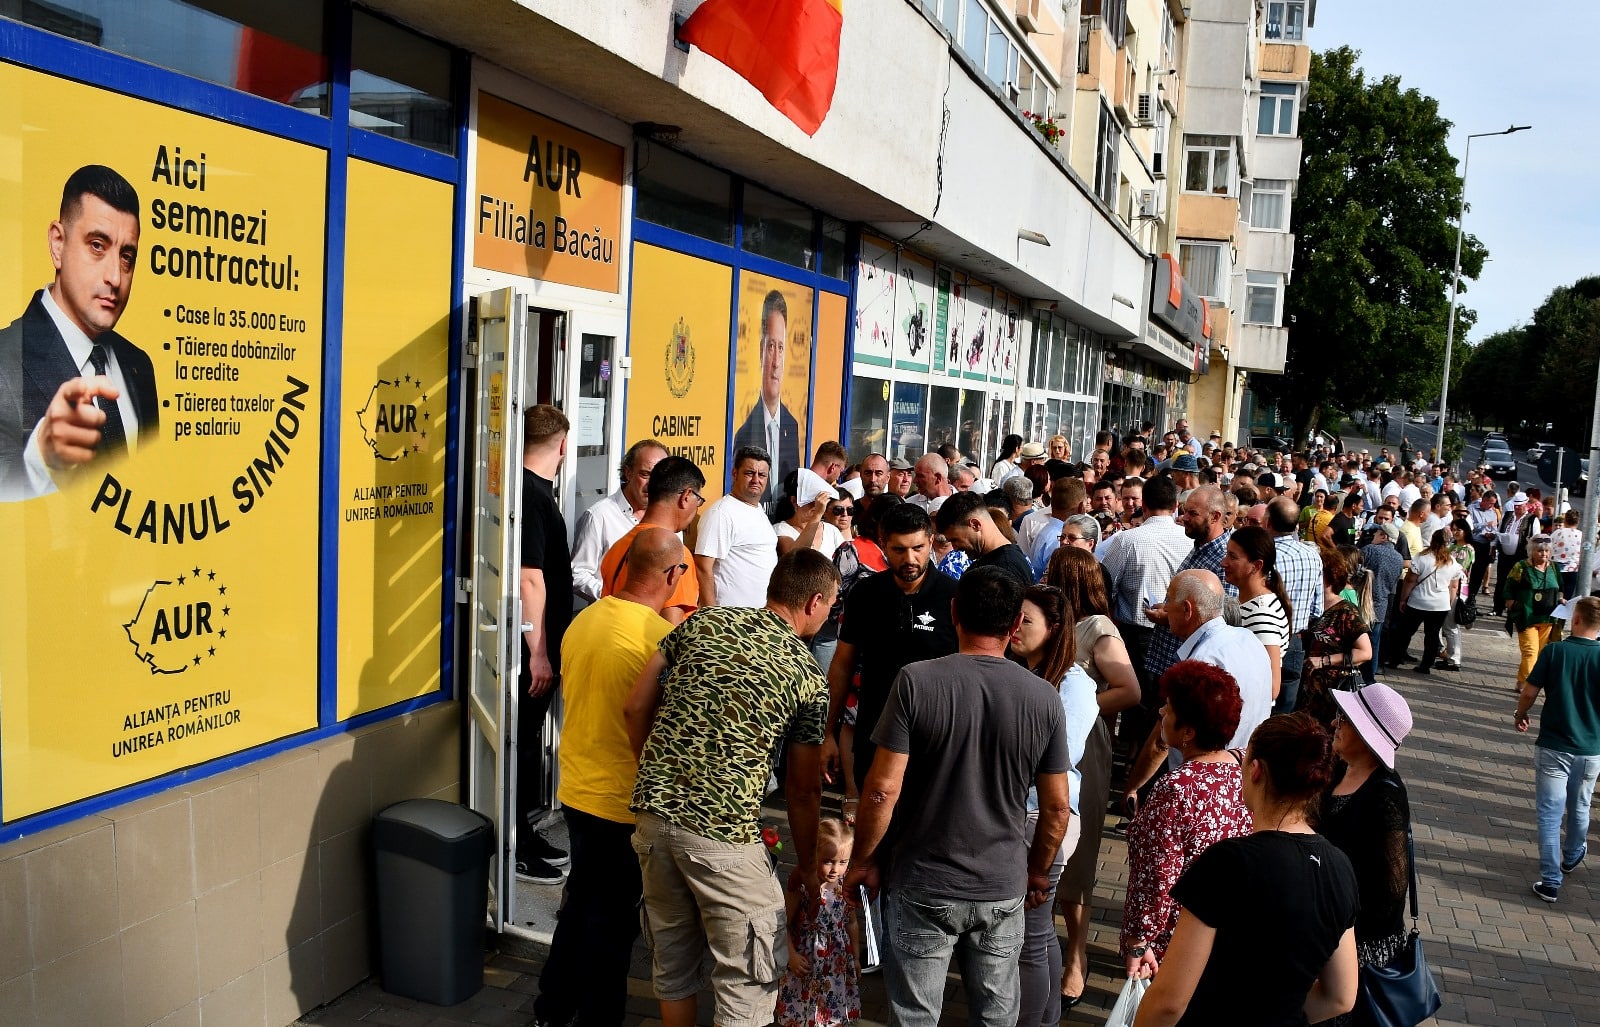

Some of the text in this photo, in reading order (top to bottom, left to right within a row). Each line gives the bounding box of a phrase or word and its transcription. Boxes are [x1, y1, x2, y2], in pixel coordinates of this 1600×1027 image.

[151, 144, 206, 192] Aici
[523, 134, 582, 199] AUR
[150, 198, 267, 247] semnezi
[478, 193, 614, 264] Filiala Bacău
[149, 244, 300, 292] contractul:
[176, 304, 306, 333] Case la 35.000 Euro
[175, 335, 297, 362] Tăierea dobânzilor
[175, 360, 239, 382] la credite
[175, 392, 275, 413] Tăierea taxelor
[374, 403, 418, 433] AUR
[174, 416, 241, 441] pe salariu
[652, 414, 702, 437] CABINET
[90, 374, 310, 545] PLANUL SIMION
[345, 500, 434, 522] UNIREA ROMÂNILOR
[353, 483, 428, 503] ALIANȚA PENTRU
[150, 601, 214, 645] AUR
[123, 689, 232, 732] ALIANȚA PENTRU
[112, 708, 241, 758] UNIREA ROMÂNILOR
